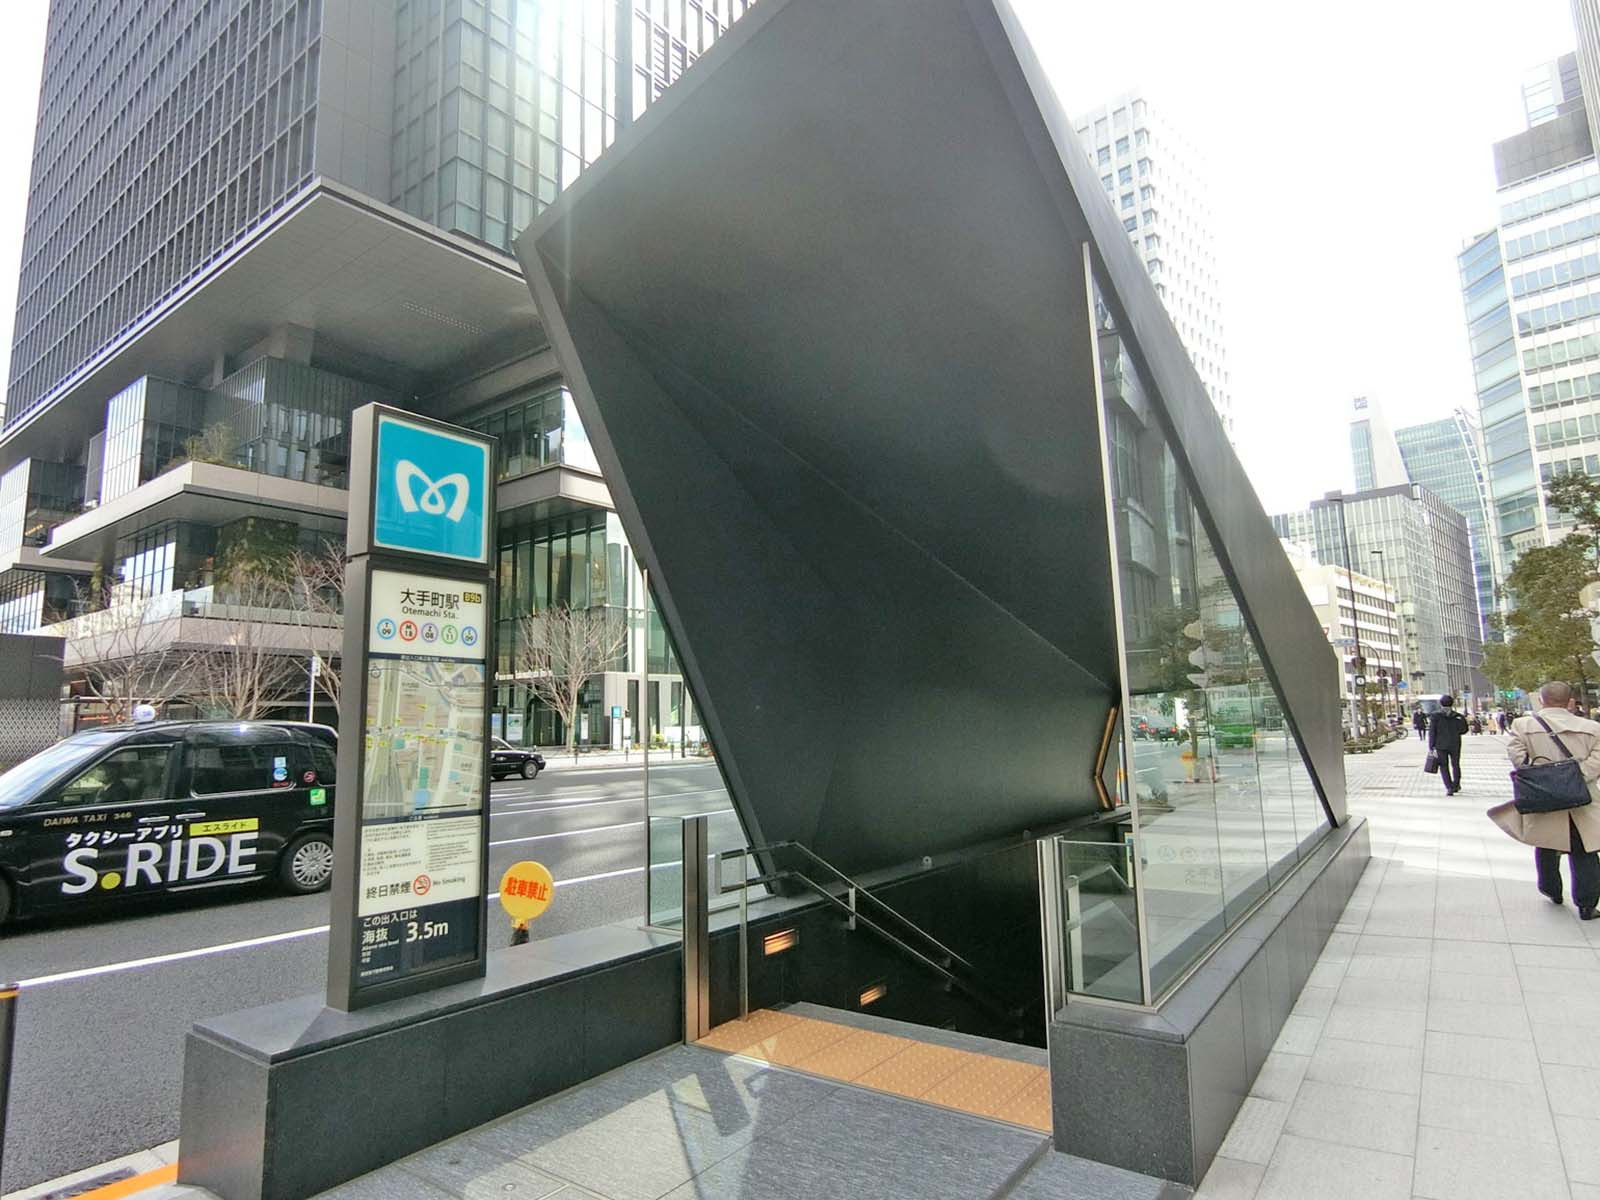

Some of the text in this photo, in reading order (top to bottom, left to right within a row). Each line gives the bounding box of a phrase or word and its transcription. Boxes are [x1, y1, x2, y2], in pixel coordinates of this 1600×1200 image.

[401, 588, 460, 610] 大手町駅
[402, 606, 441, 617] Otemachi
[43, 816, 79, 827] DAIWA
[83, 813, 108, 823] TAXI
[202, 821, 248, 832] エスライド
[65, 824, 184, 848] タクシーアプリ
[366, 881, 411, 899] 終日禁煙
[504, 876, 549, 902] 駐車禁止
[363, 909, 418, 927] この出入口は
[362, 927, 389, 944] 海抜
[406, 921, 449, 943] 3.5m
